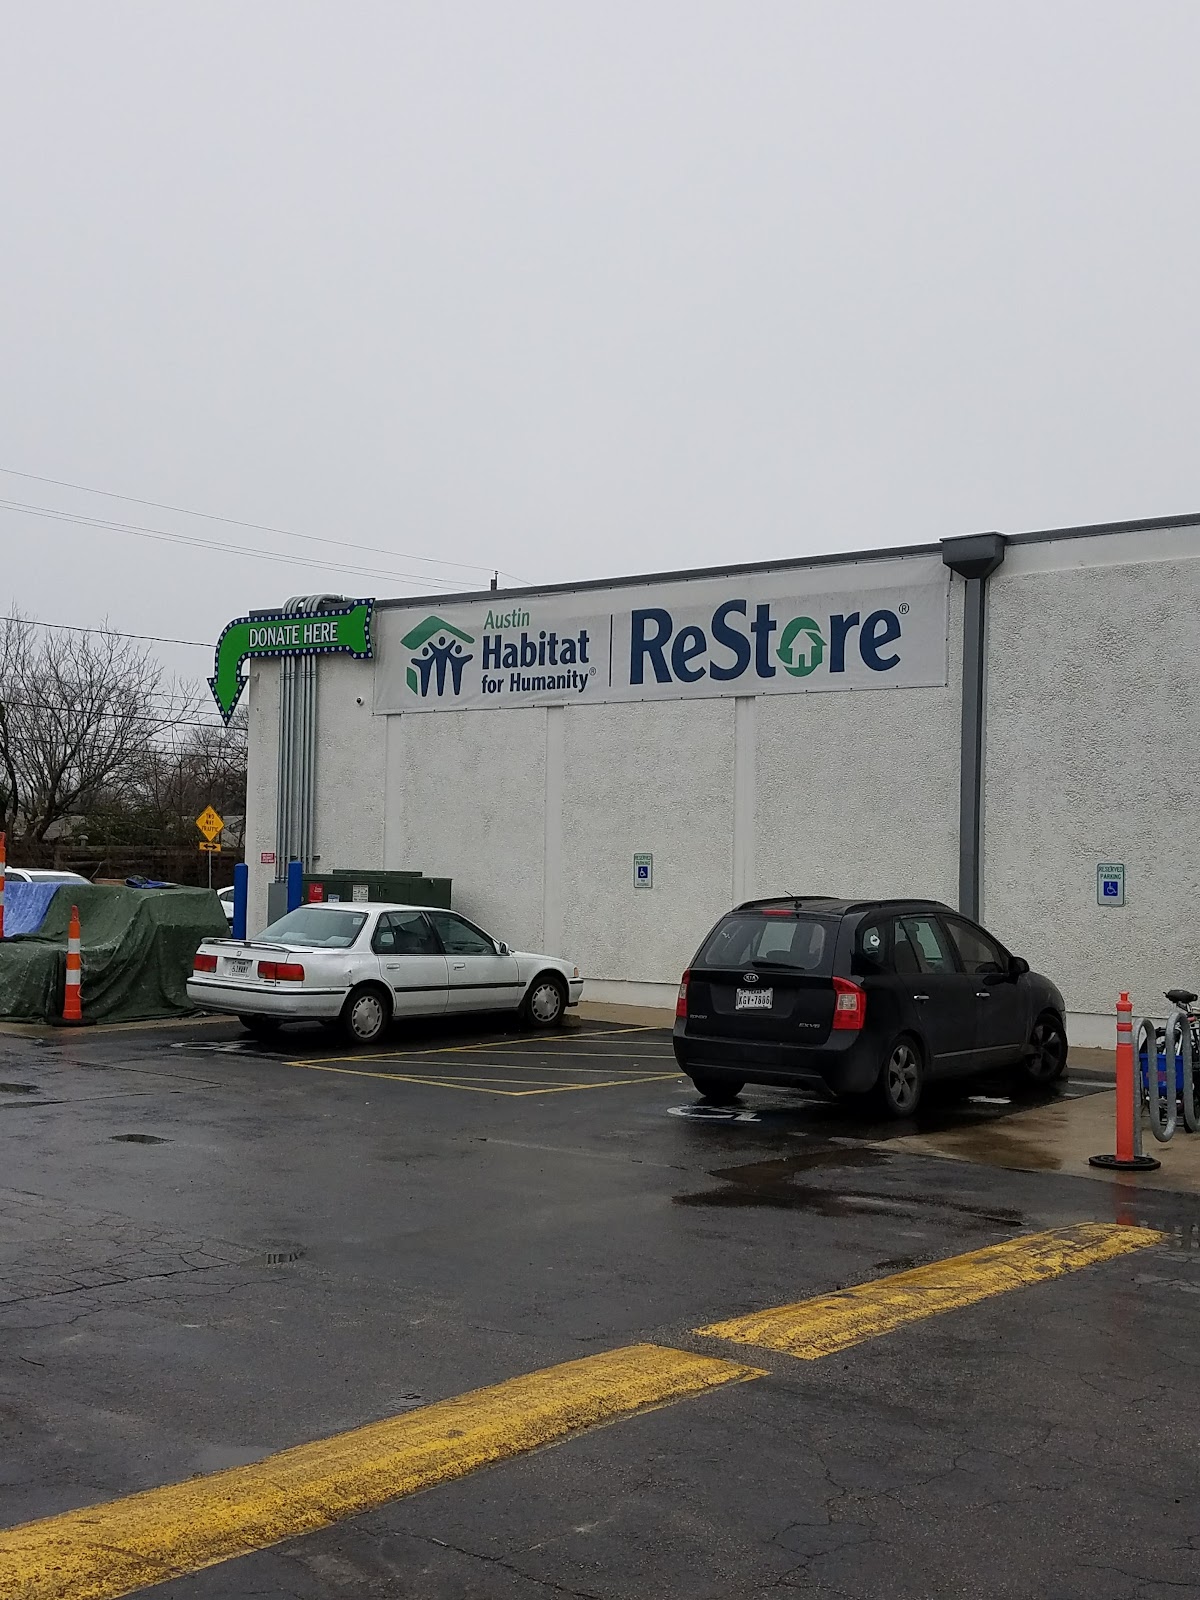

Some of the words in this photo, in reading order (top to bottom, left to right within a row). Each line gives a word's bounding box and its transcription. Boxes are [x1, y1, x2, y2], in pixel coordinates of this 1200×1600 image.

[483, 607, 530, 630] Austin
[249, 624, 300, 648] DONATE
[303, 621, 338, 644] HERE
[629, 599, 902, 685] ReStore
[482, 630, 590, 670] Habitat
[481, 674, 504, 694] for
[509, 669, 589, 693] Humanity
